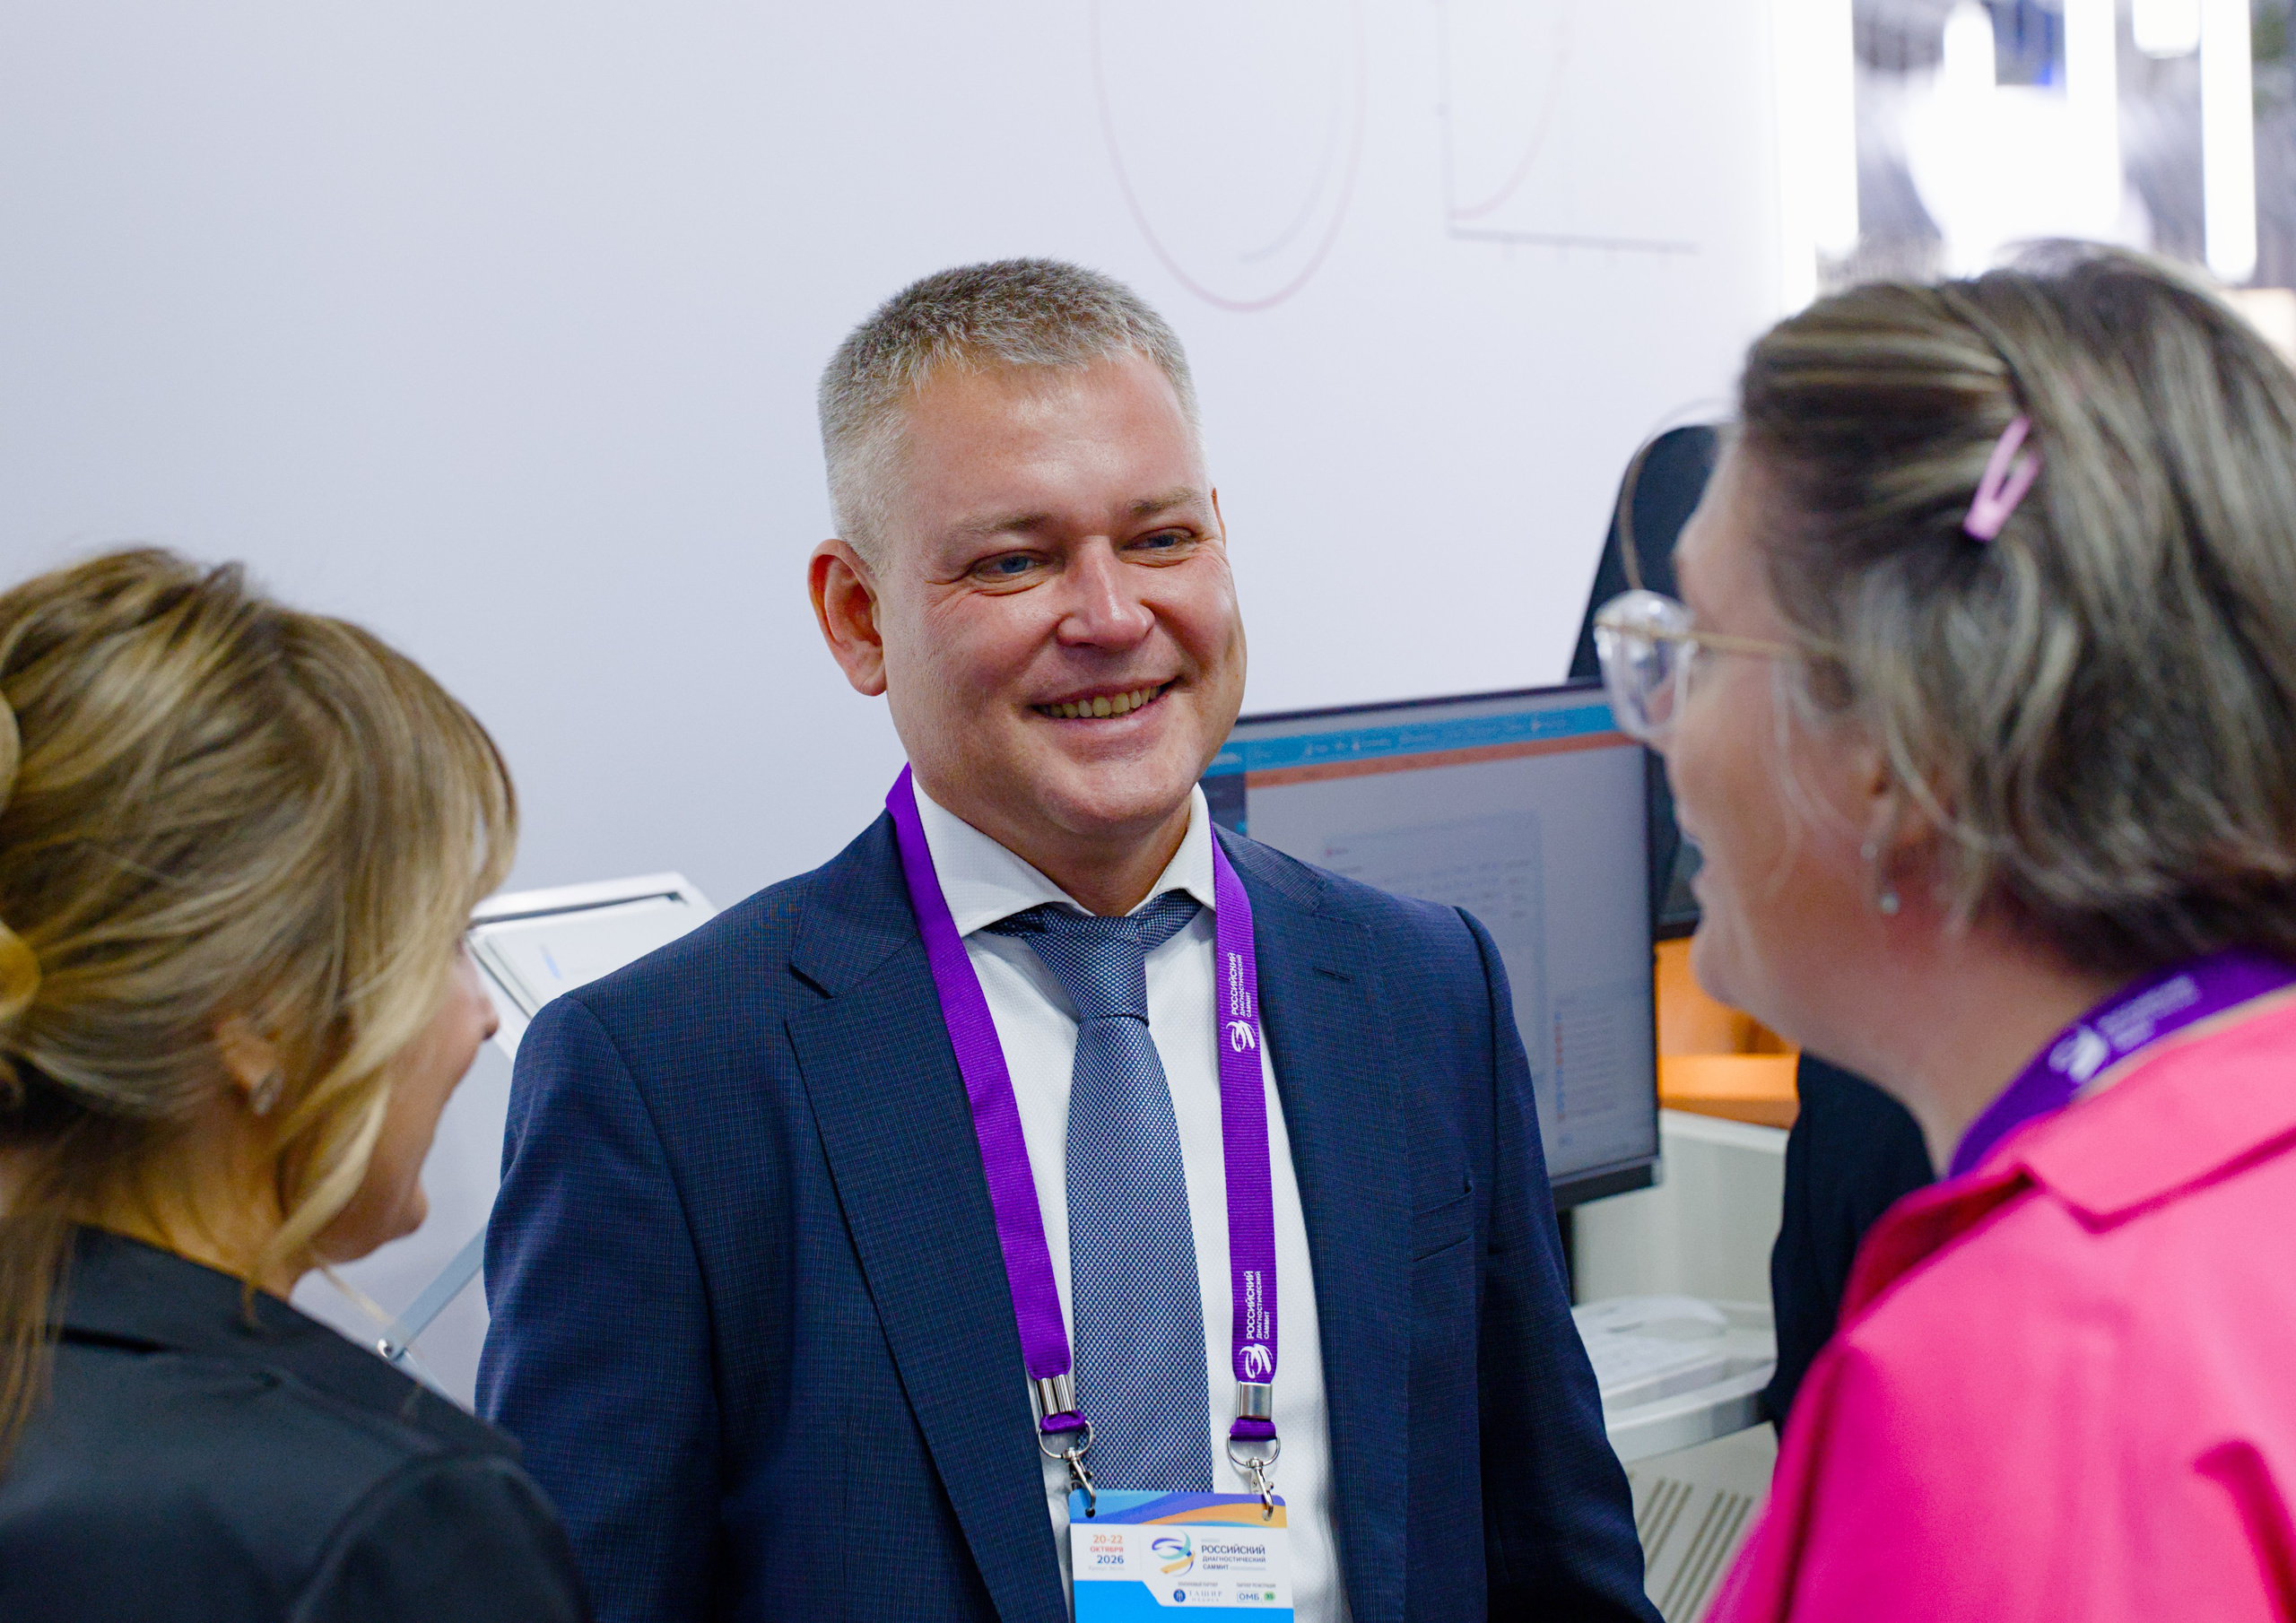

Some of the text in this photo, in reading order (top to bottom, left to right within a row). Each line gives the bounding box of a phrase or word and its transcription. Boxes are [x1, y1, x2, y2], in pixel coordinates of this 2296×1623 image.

[1228, 952, 1239, 1016] РОССИЙСКИЙ
[1237, 954, 1246, 1017] ДИАГНОСТИЧЕСКИЙ
[1244, 1271, 1255, 1340] РОССИЙСКИЙ
[1255, 1271, 1264, 1340] ДИАГНОСТИЧЕСКИЙ
[1092, 1534, 1123, 1544] 20-22
[1097, 1555, 1125, 1565] 2026
[1201, 1543, 1265, 1555] РОССИЙСКИЙ
